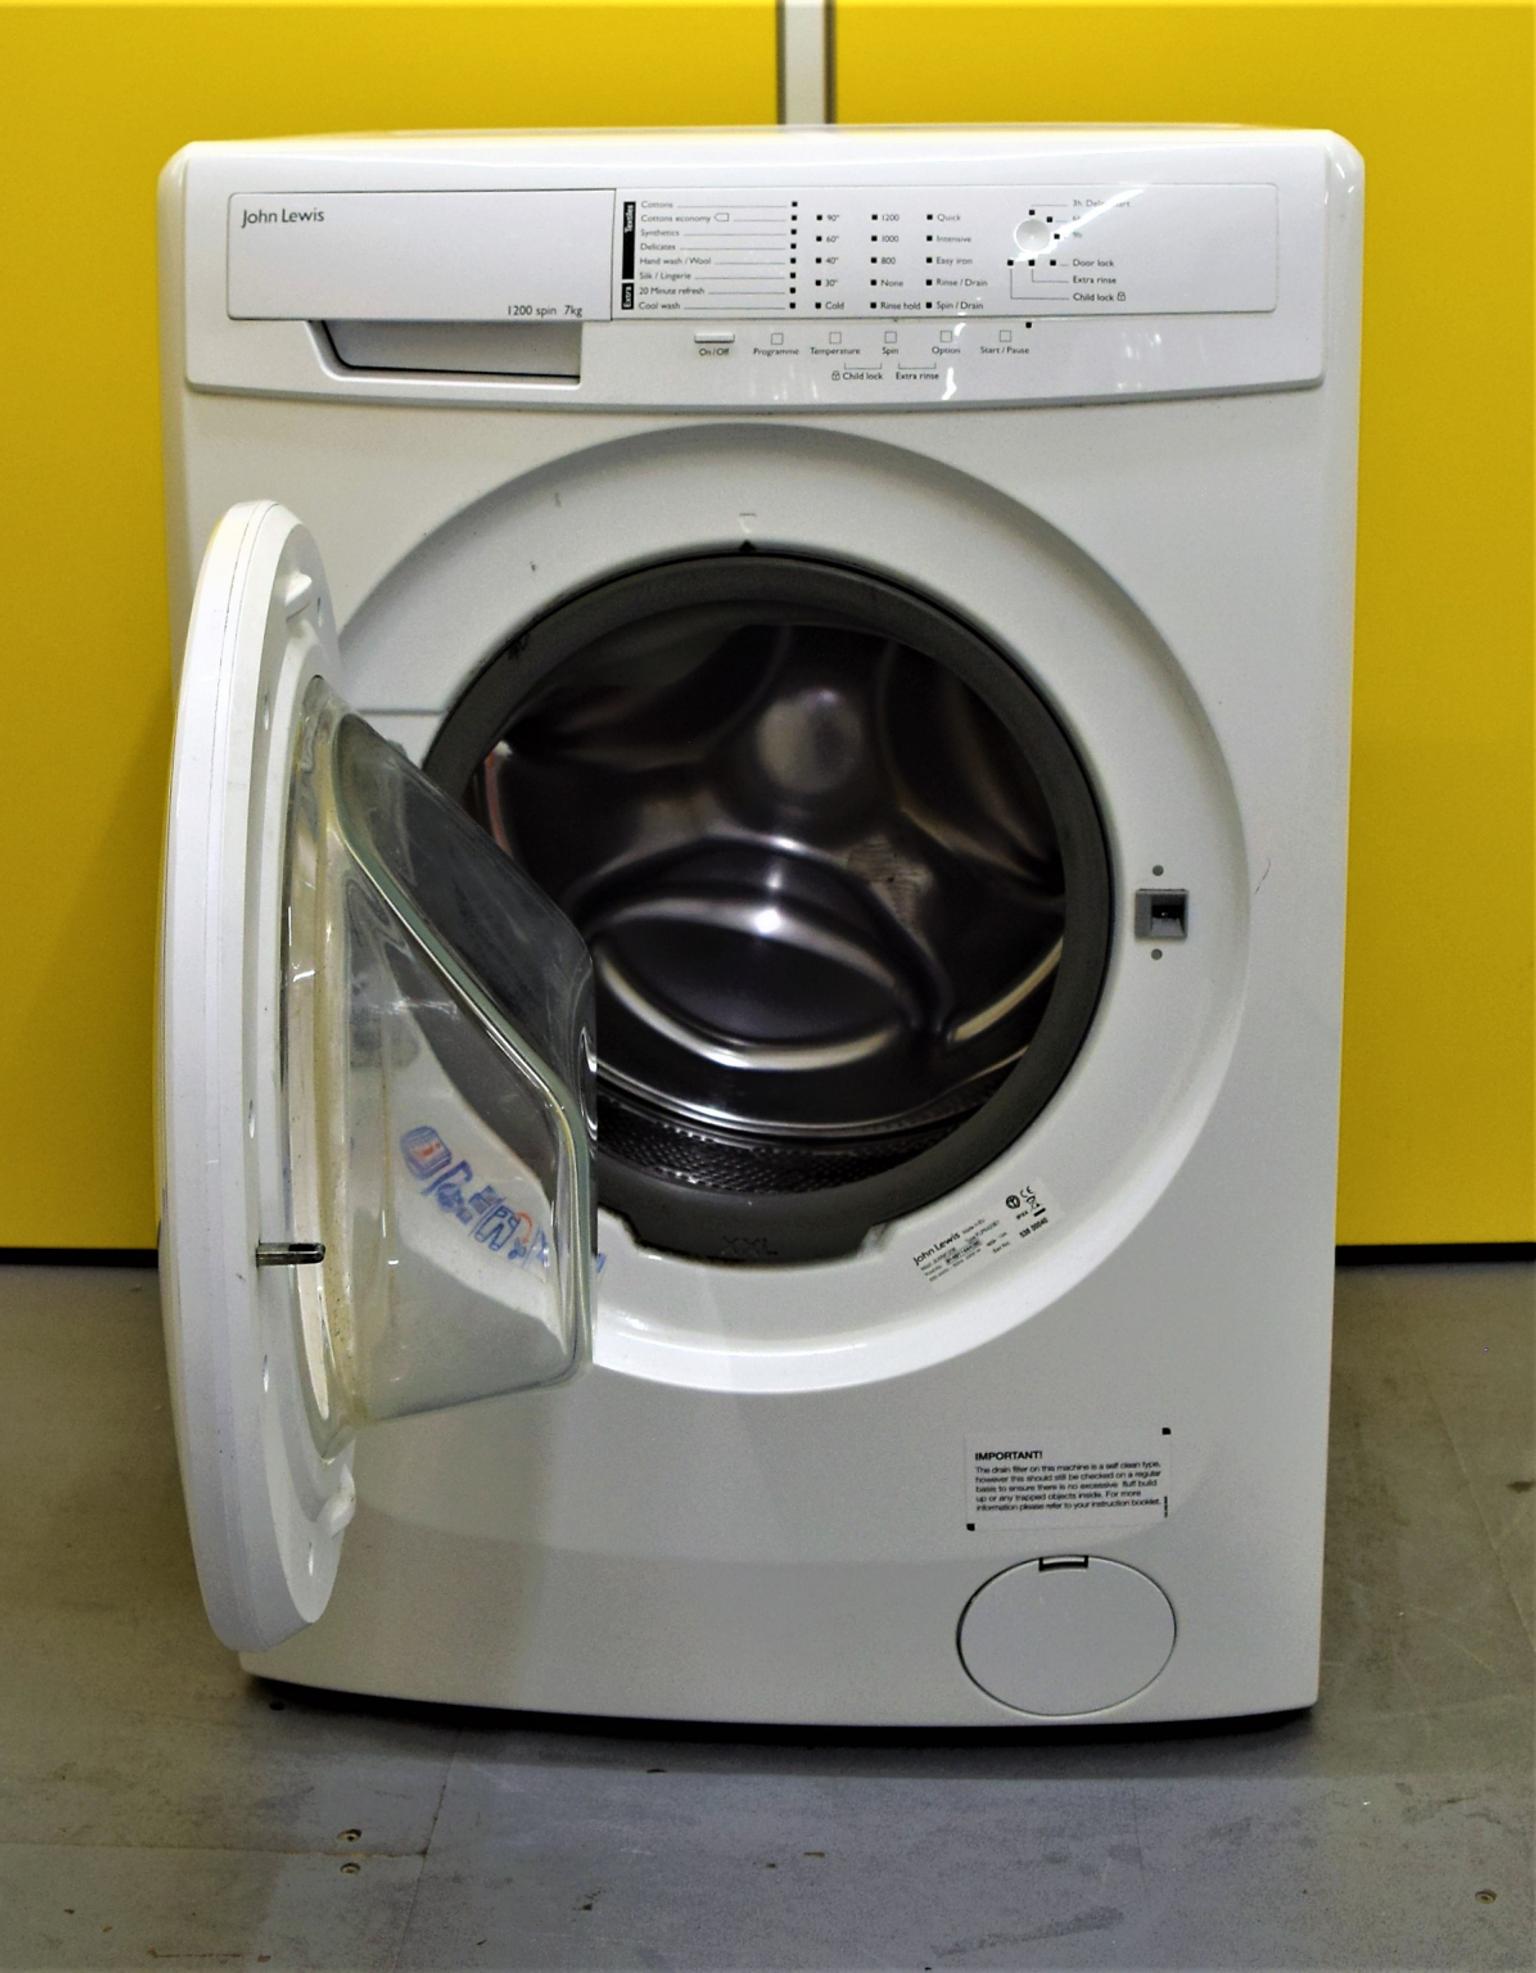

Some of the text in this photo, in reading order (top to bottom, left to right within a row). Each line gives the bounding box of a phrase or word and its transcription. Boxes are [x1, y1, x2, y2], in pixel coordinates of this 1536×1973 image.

[241, 207, 324, 229] John Lewis
[624, 205, 635, 233] Textiles
[937, 214, 961, 222] Quick
[640, 229, 679, 237] Synthetics
[936, 235, 972, 243] Intensive
[640, 243, 676, 251] Delicates
[640, 257, 661, 265] Hand
[936, 257, 953, 266] Easy
[1072, 259, 1114, 267] Door lock
[639, 272, 652, 280] Silk
[660, 272, 691, 282] Lingerie
[1072, 276, 1094, 284] Extra
[936, 278, 958, 286] Rinse
[650, 287, 676, 295] Minute
[678, 287, 705, 295] refresh
[1072, 292, 1114, 302] Child lock
[638, 302, 680, 310] Cool wash
[825, 302, 845, 310] Cold
[880, 302, 921, 310] Rinse hold
[936, 301, 954, 310] Spin
[961, 301, 983, 309] Drain
[507, 305, 583, 318] 1200 spin 7kg
[753, 347, 799, 357] Programme
[810, 346, 861, 356] Temperature
[881, 346, 899, 356] Spin
[931, 346, 961, 356] Option
[980, 346, 1000, 355] Start
[1006, 346, 1030, 355] Pause
[843, 371, 883, 381] Child lock
[896, 371, 940, 381] Extra rinse
[913, 1248, 935, 1266] John
[934, 1232, 960, 1250] Lewis
[975, 1451, 1043, 1461] IMPORTANT!
[1057, 1462, 1089, 1472] machine
[1135, 1470, 1161, 1478] regular
[1048, 1493, 1076, 1501] objects
[1064, 1501, 1072, 1509] to
[1073, 1501, 1090, 1509] your
